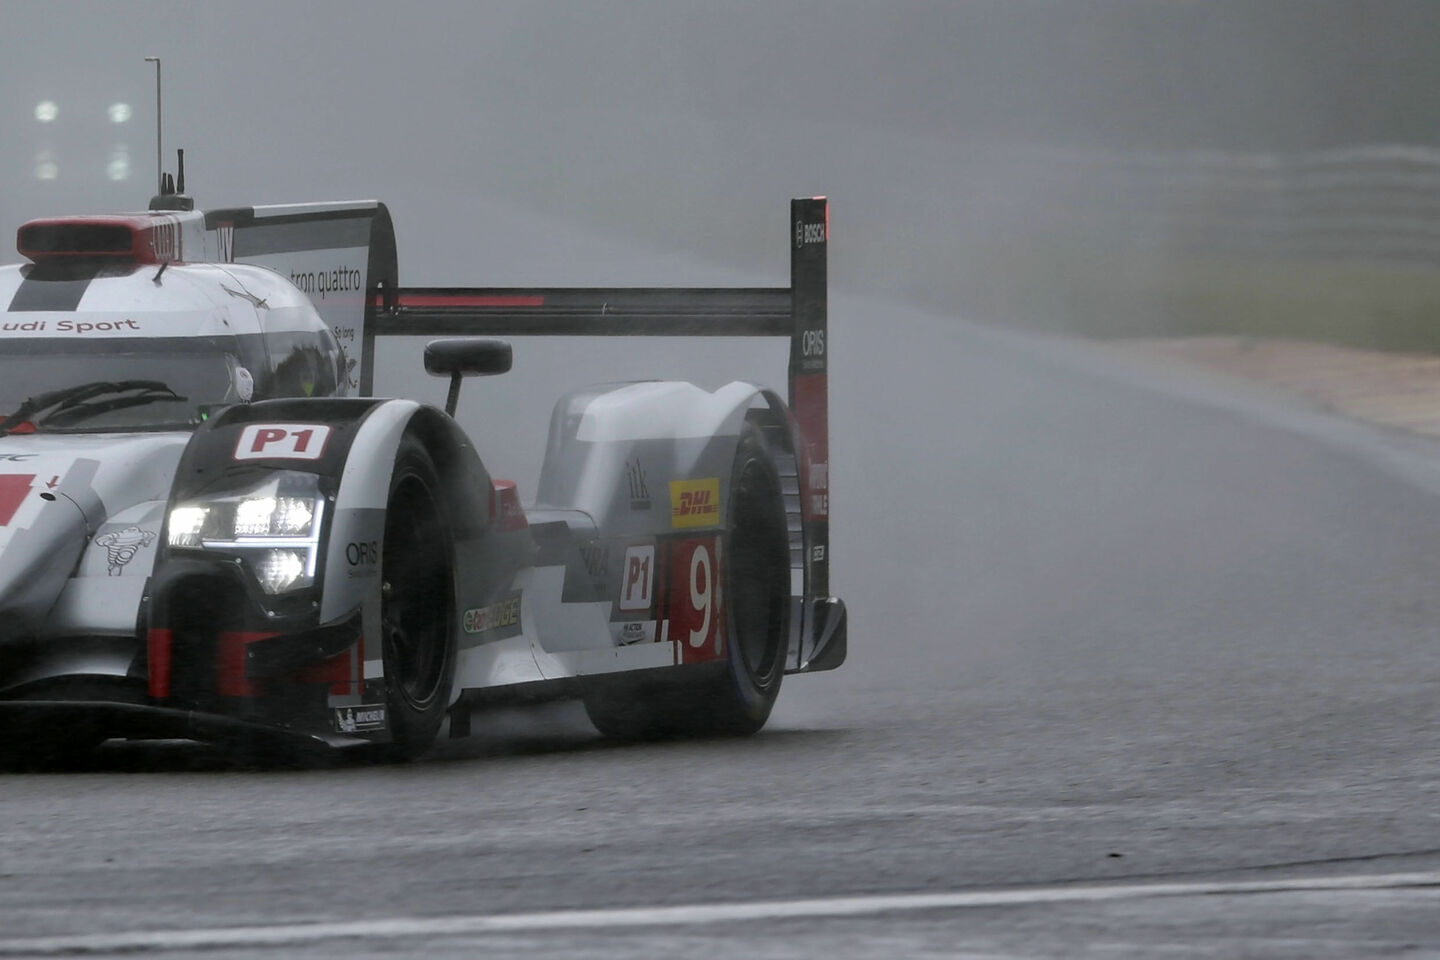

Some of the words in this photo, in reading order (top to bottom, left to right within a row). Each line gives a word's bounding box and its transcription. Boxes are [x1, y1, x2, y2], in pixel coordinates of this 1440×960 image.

[804, 223, 825, 243] BOSCH
[318, 265, 360, 299] quattro
[56, 318, 140, 334] Sport
[802, 330, 824, 356] ORIS
[250, 428, 314, 453] P1
[679, 490, 712, 516] DHL
[346, 541, 378, 567] ORIS
[625, 556, 650, 601] P1
[689, 545, 712, 648] 9
